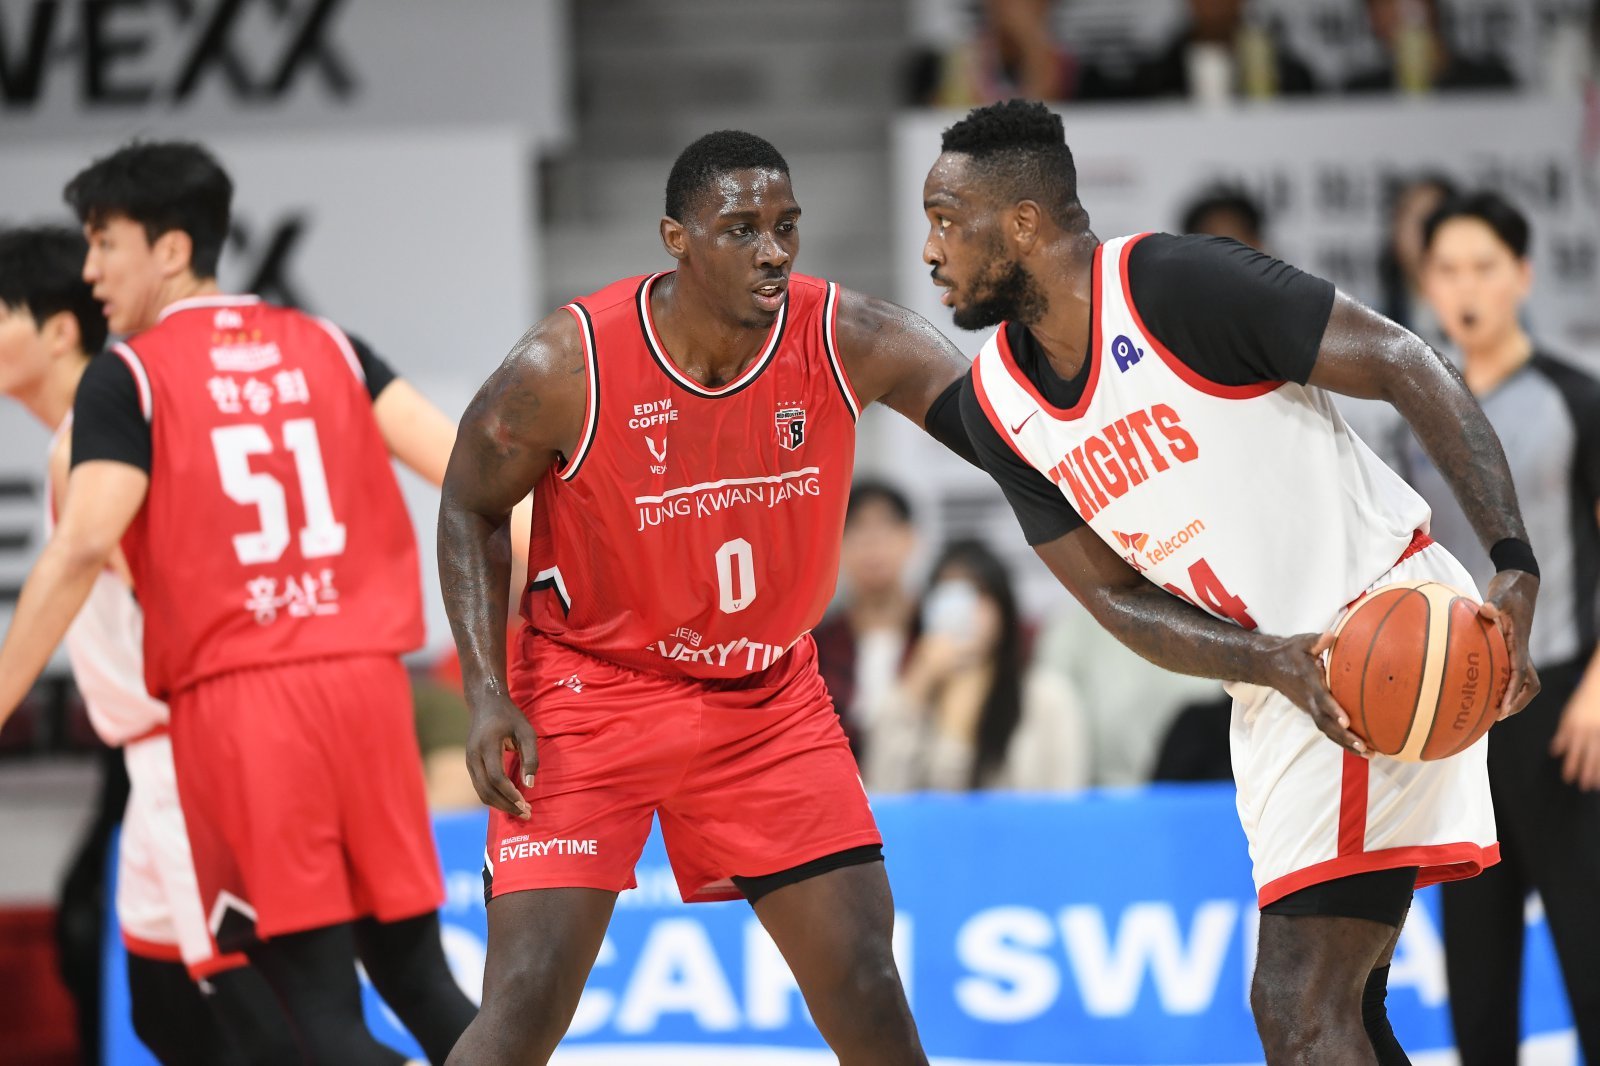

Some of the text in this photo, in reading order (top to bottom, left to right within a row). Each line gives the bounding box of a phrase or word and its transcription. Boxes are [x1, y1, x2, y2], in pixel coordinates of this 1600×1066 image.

[633, 398, 673, 416] EDIYA
[210, 418, 346, 565] 51
[638, 477, 820, 531] JUNG KWAN JANG
[1146, 518, 1206, 566] telecom
[715, 538, 757, 614] 0
[1453, 651, 1480, 731] molten
